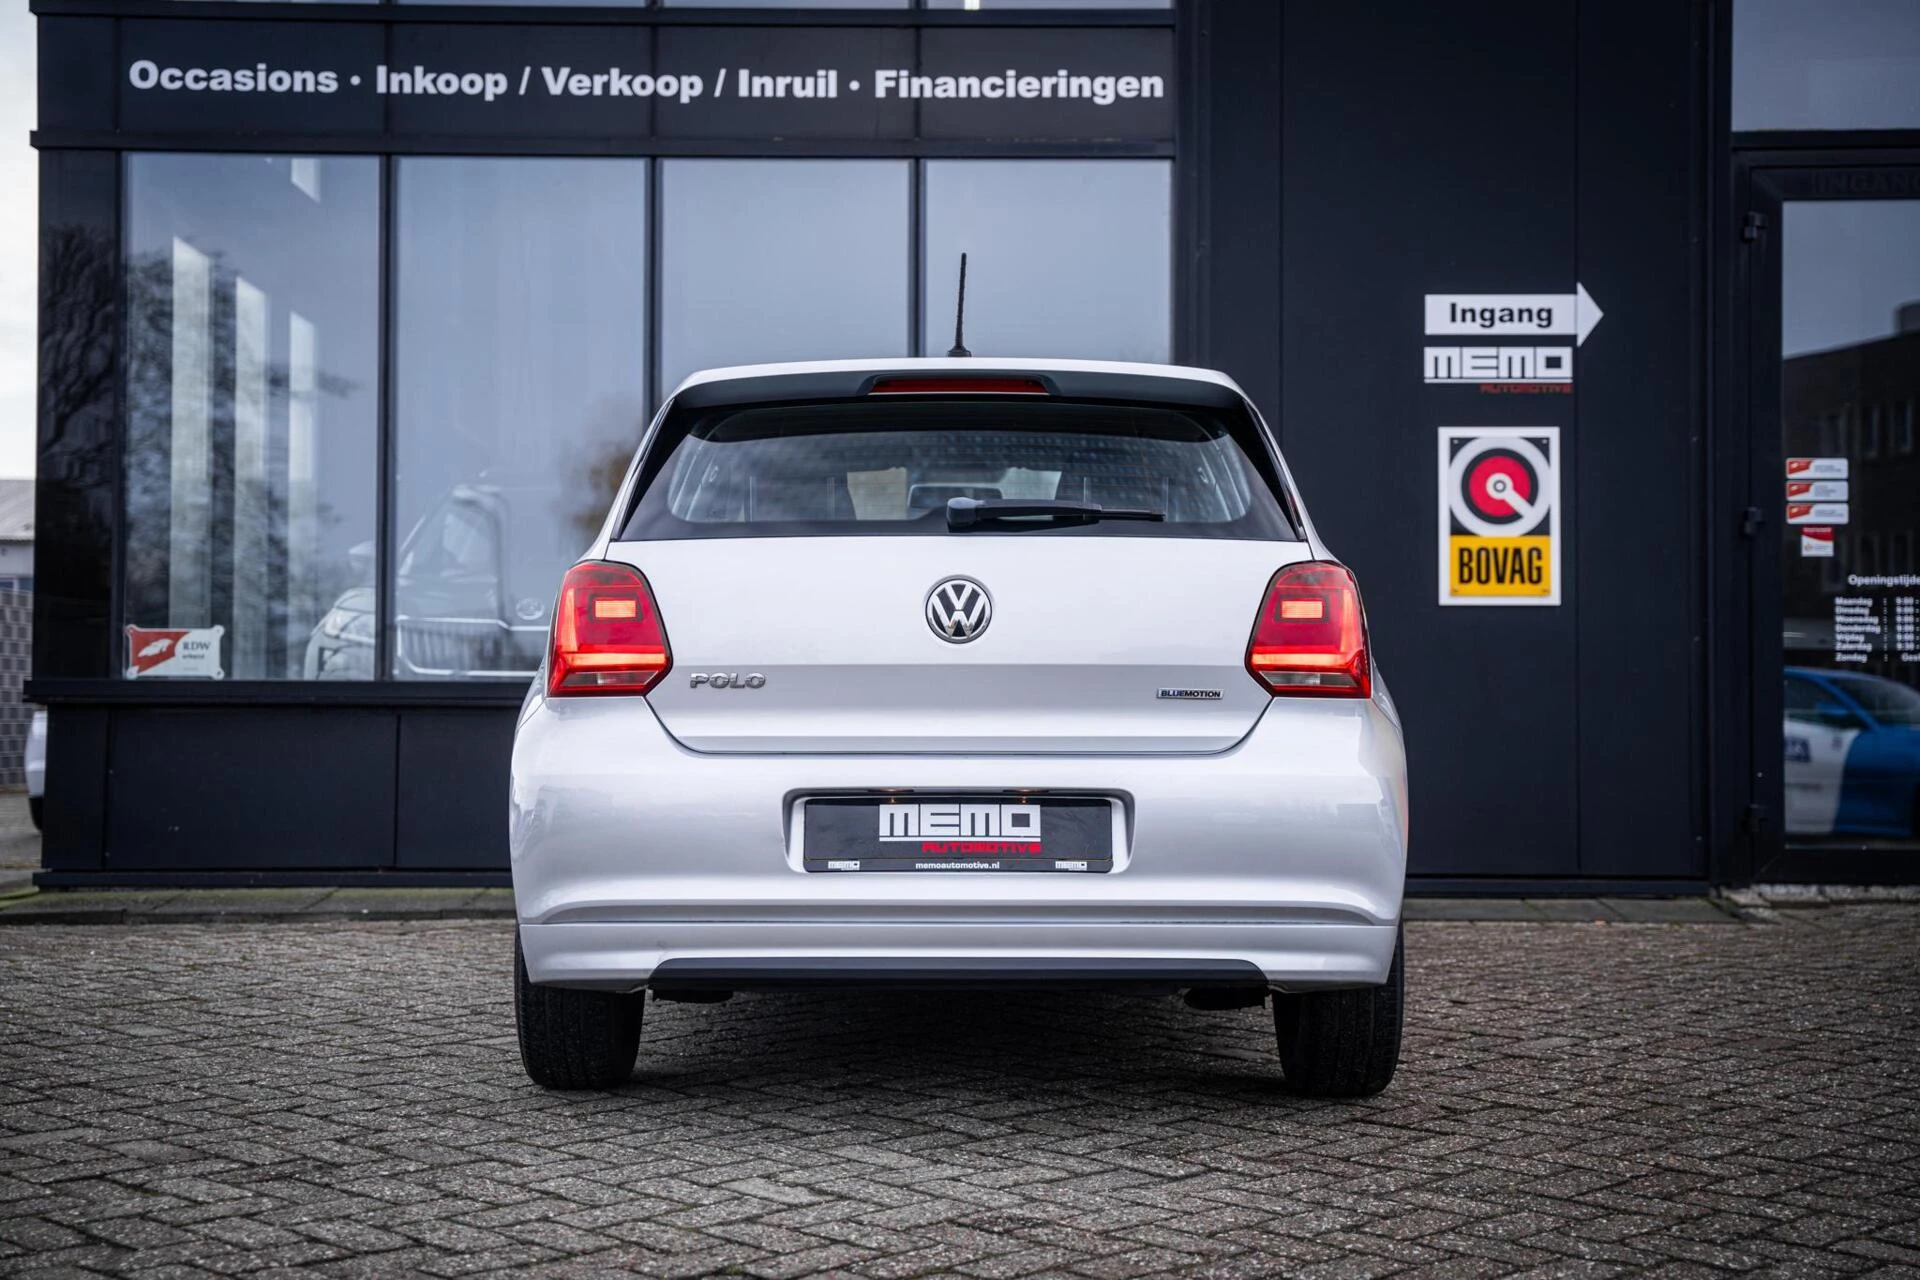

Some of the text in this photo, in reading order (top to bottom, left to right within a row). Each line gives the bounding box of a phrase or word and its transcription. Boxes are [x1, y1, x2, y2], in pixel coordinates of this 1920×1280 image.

[129, 59, 339, 93] Occasions
[376, 64, 508, 101] Inkoop
[541, 66, 704, 103] Verkoop
[738, 68, 838, 98] Inruil
[874, 68, 1165, 106] Financieringen
[1450, 302, 1554, 328] Ingang
[1424, 347, 1573, 384] MEMO
[1458, 547, 1543, 586] BOVAG
[182, 641, 212, 651] RDW
[690, 672, 766, 689] POLO
[1161, 690, 1221, 698] BLUEMOTION
[879, 804, 1041, 842] MEMO
[921, 842, 1042, 854] AUTOMOTIVE
[915, 862, 1000, 870] memoautomotive.nl
